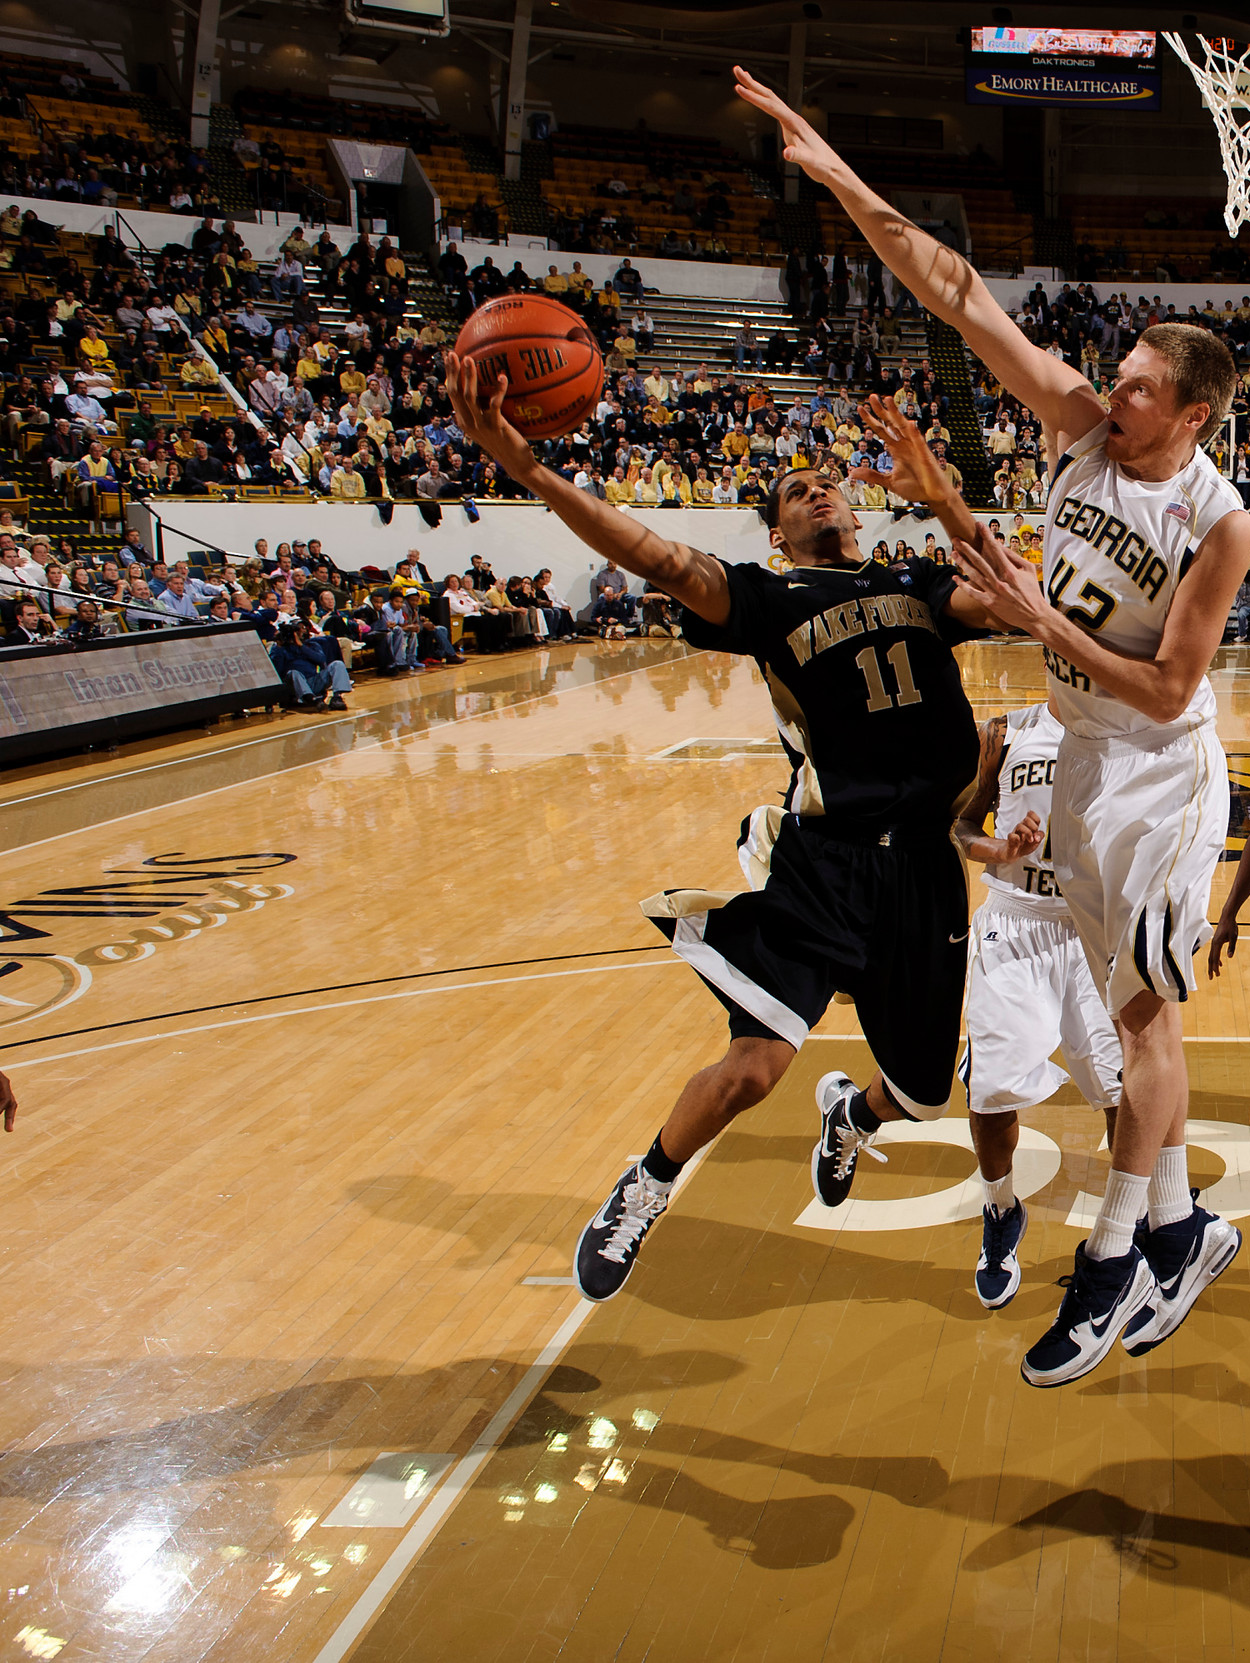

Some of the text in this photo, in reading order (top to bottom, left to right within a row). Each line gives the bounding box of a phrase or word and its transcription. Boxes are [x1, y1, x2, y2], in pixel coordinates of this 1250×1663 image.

[1032, 57, 1095, 67] DAKTRONICS
[519, 348, 568, 381] THE
[1054, 497, 1169, 604] GEORGIA
[786, 594, 943, 667] WAKE FORES
[63, 671, 143, 703] Iman
[141, 649, 255, 692] Shumpert
[855, 640, 922, 713] 11
